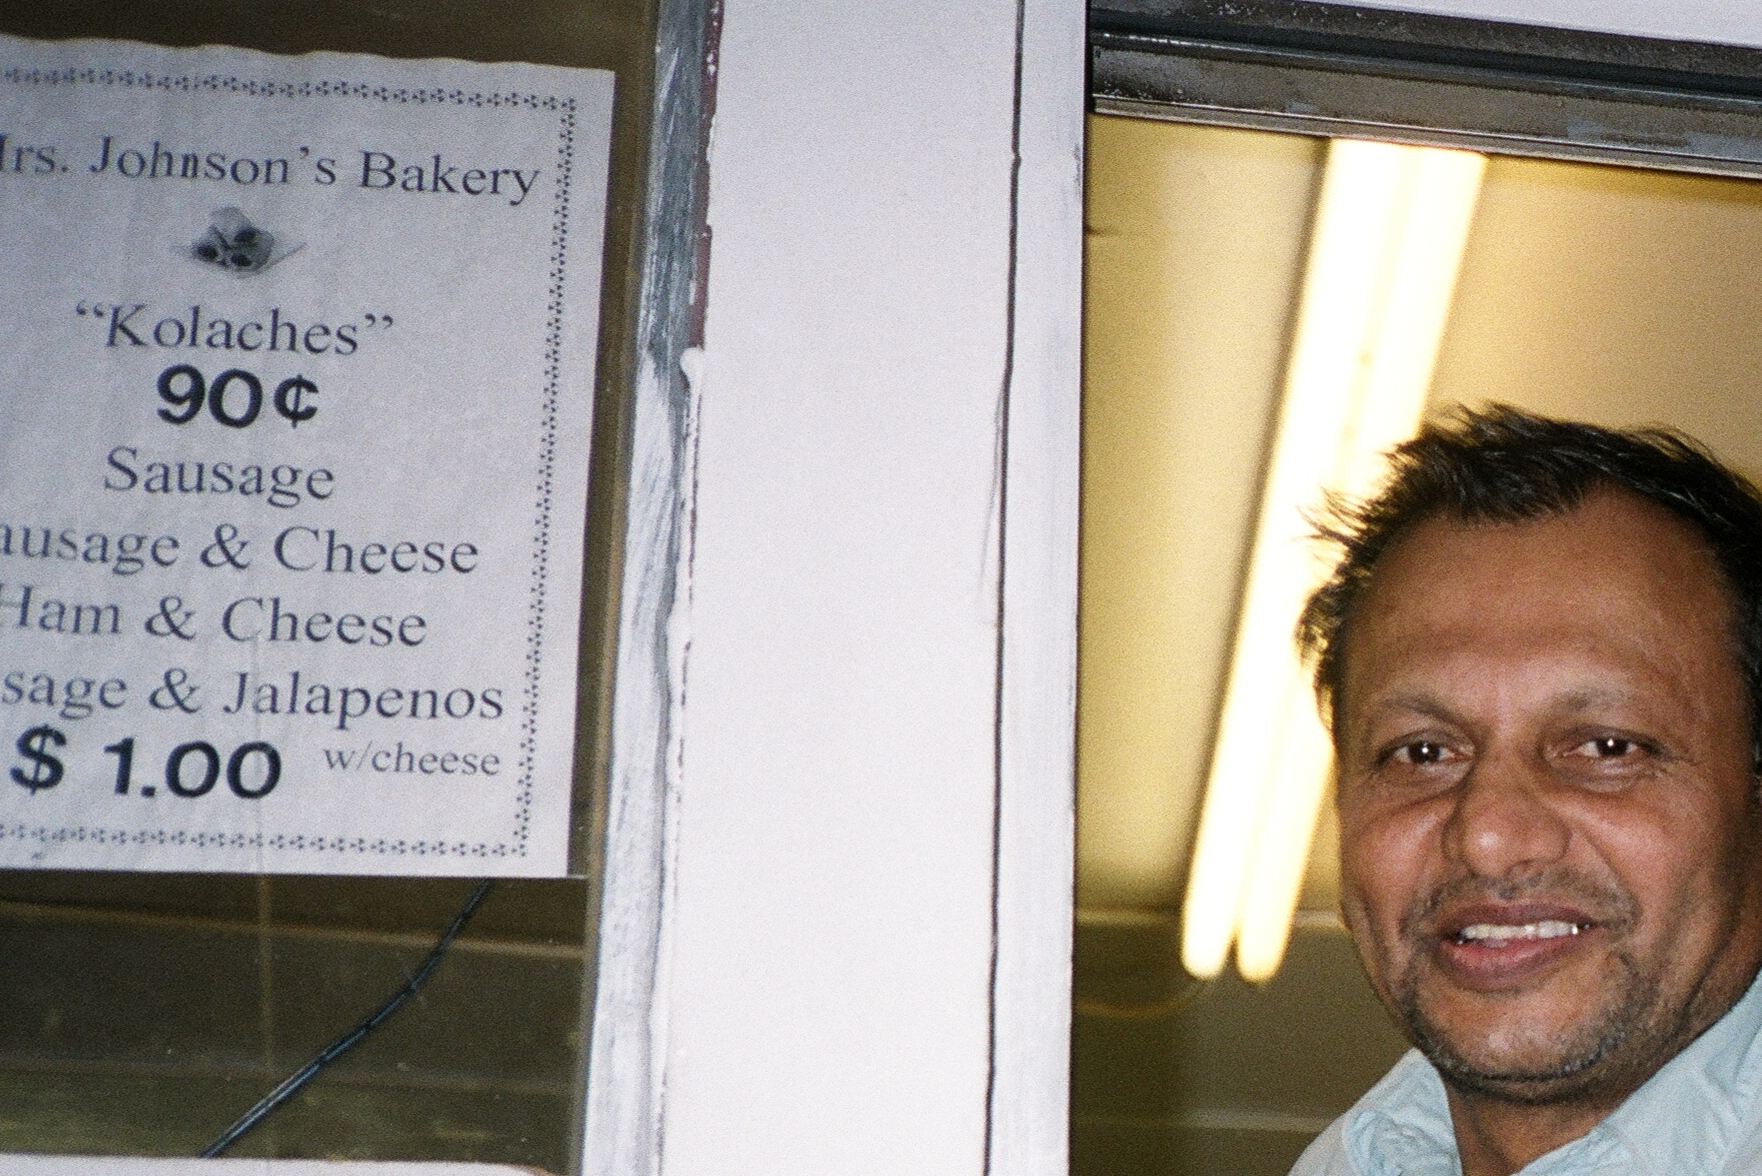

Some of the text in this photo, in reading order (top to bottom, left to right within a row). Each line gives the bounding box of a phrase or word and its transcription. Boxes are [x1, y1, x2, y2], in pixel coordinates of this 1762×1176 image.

[359, 149, 541, 206] Bakery
[155, 363, 320, 428] 90¢
[103, 445, 335, 509] Sausage
[200, 523, 251, 571] &
[272, 525, 480, 574] Cheese
[144, 595, 196, 641] &
[221, 596, 427, 647] Cheese
[149, 667, 202, 714] &
[223, 670, 505, 731] Jalapenos
[103, 737, 283, 799] 1.00
[322, 741, 502, 778] w/cheese
